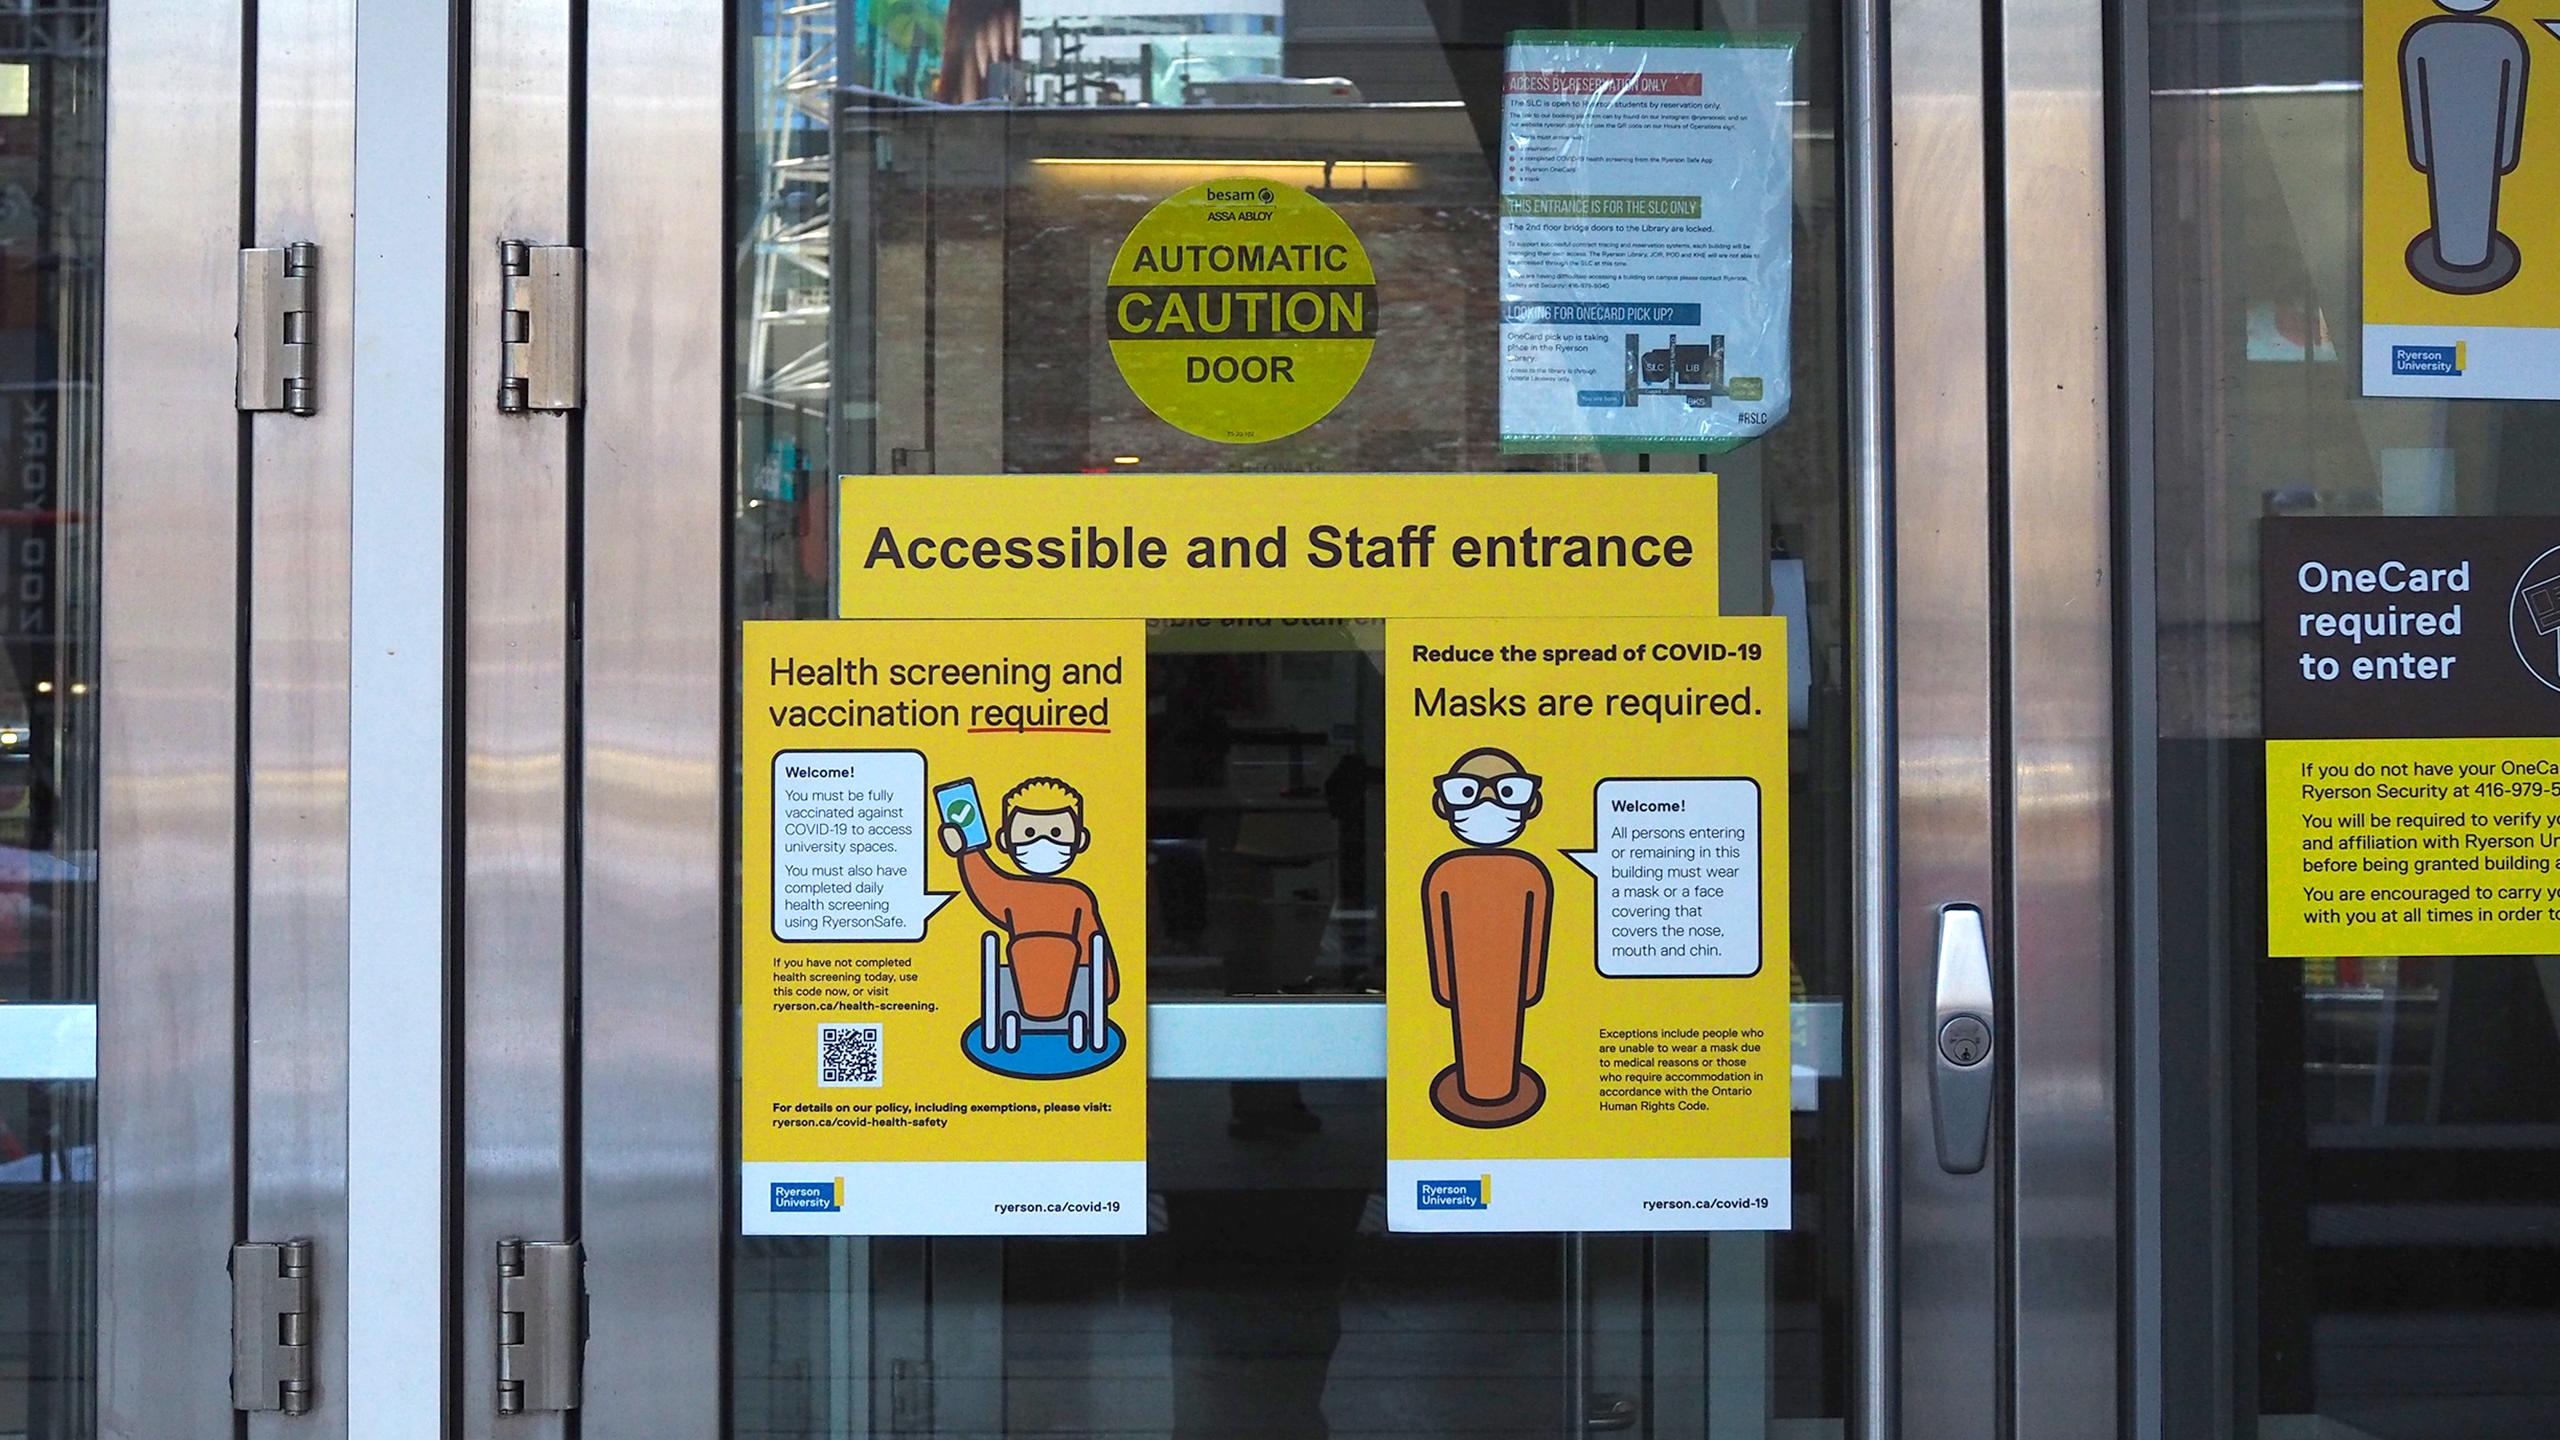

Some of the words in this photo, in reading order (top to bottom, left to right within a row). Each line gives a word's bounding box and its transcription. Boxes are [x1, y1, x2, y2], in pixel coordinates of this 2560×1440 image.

[1509, 78, 1551, 91] ACCESS
[1552, 78, 1567, 91] BY
[1641, 79, 1668, 92] ONLY
[1207, 188, 1255, 201] besam
[1534, 200, 1589, 213] ENTRANCE
[1591, 200, 1601, 213] IS
[1603, 200, 1623, 213] FOR
[1626, 200, 1646, 214] THE
[1648, 200, 1668, 214] SLC
[1670, 200, 1697, 214] ONLY
[1208, 212, 1236, 221] ASSA
[1238, 211, 1273, 221] ABLOY
[1508, 223, 1524, 231] The
[1525, 223, 1541, 231] 2nd
[1543, 223, 1561, 231] floor
[1563, 224, 1589, 233] bridge
[1591, 224, 1613, 232] doors
[1626, 224, 1640, 232] the
[1642, 225, 1669, 233] Library
[1686, 225, 1715, 233] locked.
[1132, 244, 1347, 272] AUTOMATIC
[1118, 292, 1363, 333] CAUTION
[1554, 306, 1574, 320] FOR
[1576, 306, 1625, 321] ONECARD
[1627, 307, 1651, 321] PICK
[1653, 307, 1674, 321] UP?
[2397, 350, 2442, 362] Ryerson
[1187, 356, 1295, 383] DOOR
[1646, 363, 1664, 371] SLC
[2397, 360, 2452, 373] University
[1738, 412, 1767, 425] #RSLC
[863, 526, 1167, 569] Accessible
[1187, 526, 1286, 569] and
[1307, 525, 1436, 568] Staff
[1452, 526, 1693, 568] entrance
[2298, 561, 2469, 593] OneCard
[2300, 605, 2461, 644] required
[1413, 645, 1494, 662] Reduce
[1499, 645, 1537, 662] the
[1543, 644, 1617, 666] spread
[1623, 644, 1646, 661] of
[1652, 643, 1762, 661] COVID-19
[2299, 653, 2339, 680] to
[2352, 652, 2456, 680] enter
[771, 657, 877, 686] Health
[890, 657, 1050, 693] screening
[1062, 656, 1122, 685] and
[1415, 687, 1526, 717] Masks
[1538, 694, 1593, 716] are
[1606, 686, 1761, 723] required.
[769, 699, 959, 727] vaccination
[971, 698, 1108, 732] required
[785, 766, 854, 778] Welcome!
[2302, 763, 2313, 777] If
[2318, 766, 2348, 780] you
[2354, 762, 2375, 777] do
[2381, 763, 2408, 776] not
[2414, 761, 2453, 776] have
[2458, 764, 2496, 779] your
[2501, 760, 2559, 775] OneCa
[785, 790, 808, 802] You
[812, 791, 844, 801] must
[848, 790, 864, 801] be
[868, 789, 894, 803] fully
[2302, 784, 2371, 801] Ryerson
[2376, 783, 2448, 801] Security
[2453, 785, 2470, 798] at
[2474, 782, 2560, 797] 416-979-5
[1611, 800, 1685, 812] Welcome!
[785, 806, 854, 819] vaccinated
[858, 807, 903, 821] against
[785, 823, 847, 835] COVID-19
[851, 825, 865, 835] to
[868, 826, 912, 835] access
[1611, 826, 1627, 839] All
[1632, 829, 1685, 841] persons
[1689, 827, 1745, 842] entering
[785, 841, 846, 854] university
[850, 843, 897, 855] spaces.
[2302, 835, 2333, 850] and
[2339, 835, 2417, 850] affiliation
[2423, 834, 2459, 849] with
[2465, 834, 2534, 851] Ryerson
[785, 865, 808, 877] You
[812, 866, 843, 877] must
[848, 865, 873, 876] also
[877, 865, 907, 876] have
[1612, 866, 1663, 881] building
[1668, 867, 1701, 878] must
[1706, 868, 1739, 878] wear
[785, 899, 824, 911] health
[828, 899, 889, 913] screening
[1612, 905, 1670, 920] covering
[1675, 905, 1702, 917] that
[785, 916, 818, 931] using
[822, 915, 906, 930] RyersonSafe.
[1612, 927, 1658, 937] covers
[1662, 924, 1685, 937] the
[1689, 927, 1724, 937] nose,
[1612, 944, 1656, 957] mouth
[1661, 944, 1685, 957] and
[1690, 944, 1722, 957] chin.
[773, 1001, 939, 1013] ryerson.ca/health-screening.
[1599, 1029, 1658, 1040] Exceptions
[1661, 1028, 1699, 1038] include
[1702, 1028, 1738, 1040] people
[1741, 1028, 1764, 1038] who
[1599, 1045, 1616, 1053] are
[1619, 1043, 1654, 1053] unable
[1657, 1044, 1669, 1053] to
[1671, 1045, 1698, 1053] wear
[1710, 1043, 1738, 1052] mask
[1741, 1043, 1761, 1052] due
[1599, 1072, 1622, 1082] who
[1625, 1072, 1662, 1084] require
[1665, 1072, 1751, 1082] accommodation
[1754, 1072, 1763, 1081] in
[1599, 1087, 1661, 1097] accordance
[1664, 1086, 1688, 1096] with
[1691, 1086, 1709, 1096] the
[1711, 1086, 1752, 1096] Ontario
[773, 1103, 792, 1112] For
[795, 1103, 833, 1112] details
[875, 1102, 912, 1114] policy,
[915, 1102, 967, 1115] including
[970, 1102, 1041, 1114] exemptions,
[1044, 1102, 1081, 1114] please
[1083, 1102, 1112, 1112] visit:
[1600, 1101, 1638, 1111] Human
[1641, 1101, 1675, 1113] Rights
[1678, 1100, 1709, 1111] Code.
[773, 1117, 948, 1129] ryerson.ca/covid-health-safety
[776, 1187, 820, 1198] Ryerson
[1422, 1184, 1467, 1195] Ryerson
[776, 1197, 830, 1209] University
[1422, 1194, 1477, 1207] University
[1643, 1197, 1768, 1211] ryerson.ca/covid-19
[995, 1201, 1120, 1214] ryerson.ca/covid-19
